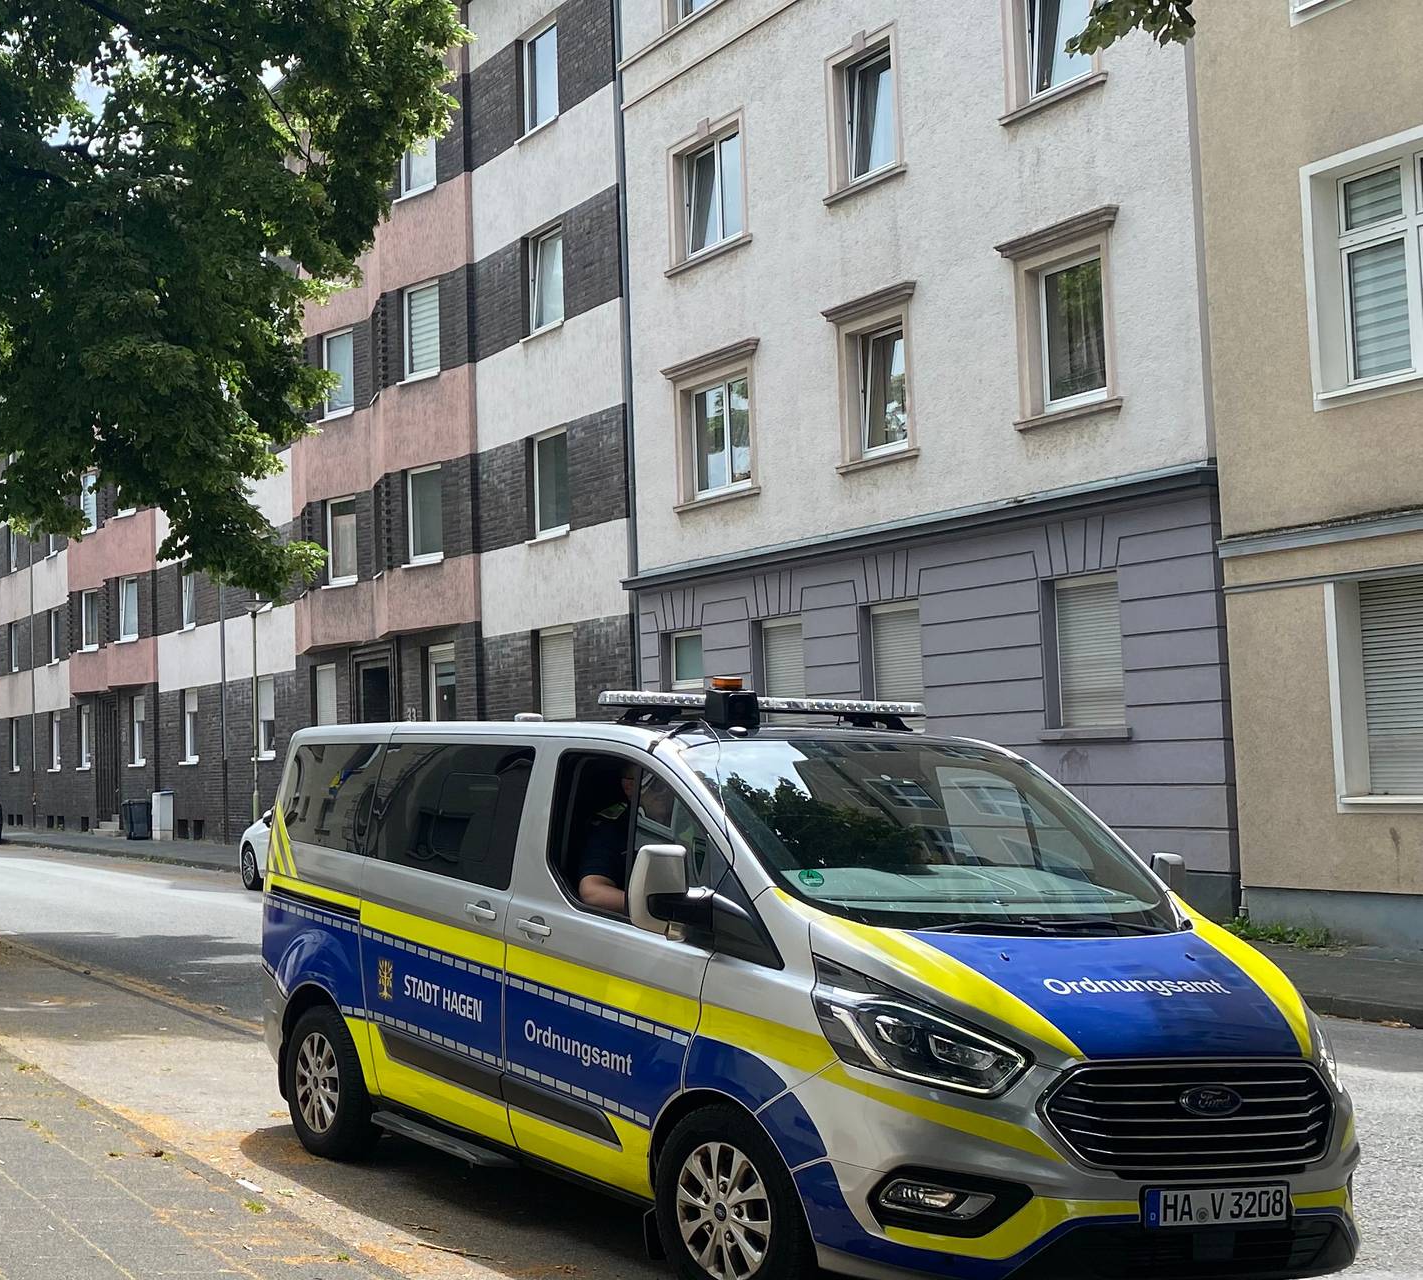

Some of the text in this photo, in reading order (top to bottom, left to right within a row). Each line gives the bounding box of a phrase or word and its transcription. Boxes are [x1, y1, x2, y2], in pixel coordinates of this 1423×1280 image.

[407, 707, 417, 722] 33
[404, 974, 482, 1022] STADT HAGEN
[1043, 976, 1231, 997] Ordnungsamt
[524, 1019, 633, 1076] Ordnungsamt
[1162, 1189, 1284, 1222] HA V 3208
